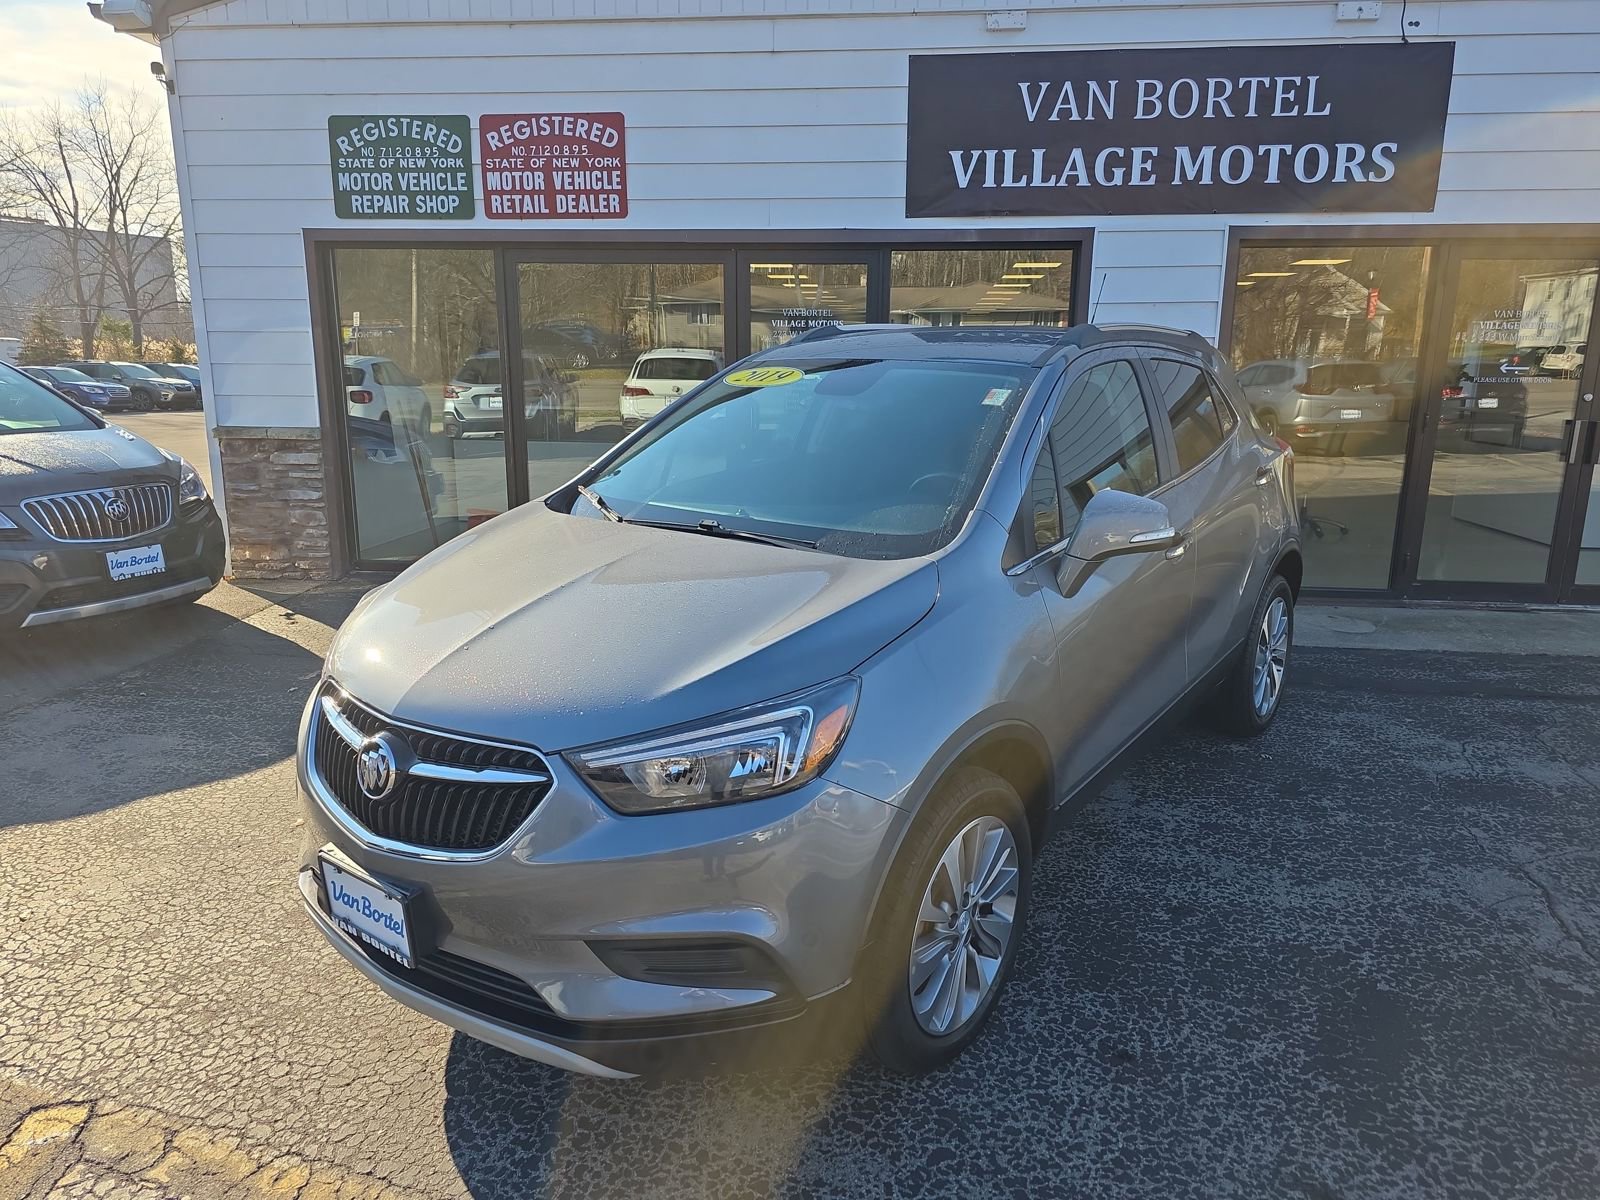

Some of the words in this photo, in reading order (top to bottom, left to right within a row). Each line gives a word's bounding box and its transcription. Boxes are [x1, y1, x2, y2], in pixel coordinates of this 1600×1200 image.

[1017, 79, 1119, 122] VAN
[1133, 74, 1332, 120] BORTEL
[336, 117, 463, 155] REGISTERED
[486, 116, 619, 151] REGISTERED
[379, 146, 440, 157] 7120895
[511, 146, 528, 156] NO.
[529, 145, 589, 156] 7120895
[338, 158, 375, 168] STATE
[379, 158, 396, 168] OF
[399, 158, 426, 168] NEW
[430, 157, 465, 168] YORK
[485, 158, 525, 168] STATE
[530, 158, 547, 168] OF
[552, 157, 580, 168] NEW
[585, 157, 621, 167] YORK
[948, 145, 1159, 189] VILLAGE
[1171, 141, 1398, 185] MOTORS
[338, 172, 394, 191] MOTOR
[397, 172, 468, 191] VEHICLE
[486, 171, 545, 191] MOTOR
[552, 170, 622, 190] VEHICLE
[351, 195, 410, 214] REPAIR
[415, 194, 460, 213] SHOP
[491, 194, 550, 213] RETAIL
[556, 194, 620, 213] DEALER
[782, 308, 799, 317] VAN
[801, 308, 833, 317] BORTEL
[1494, 310, 1514, 319] VAN
[771, 320, 806, 328] VILLAGE
[808, 319, 844, 328] MOTORS
[1480, 321, 1520, 330] VILLAGE
[733, 370, 796, 382] 2019
